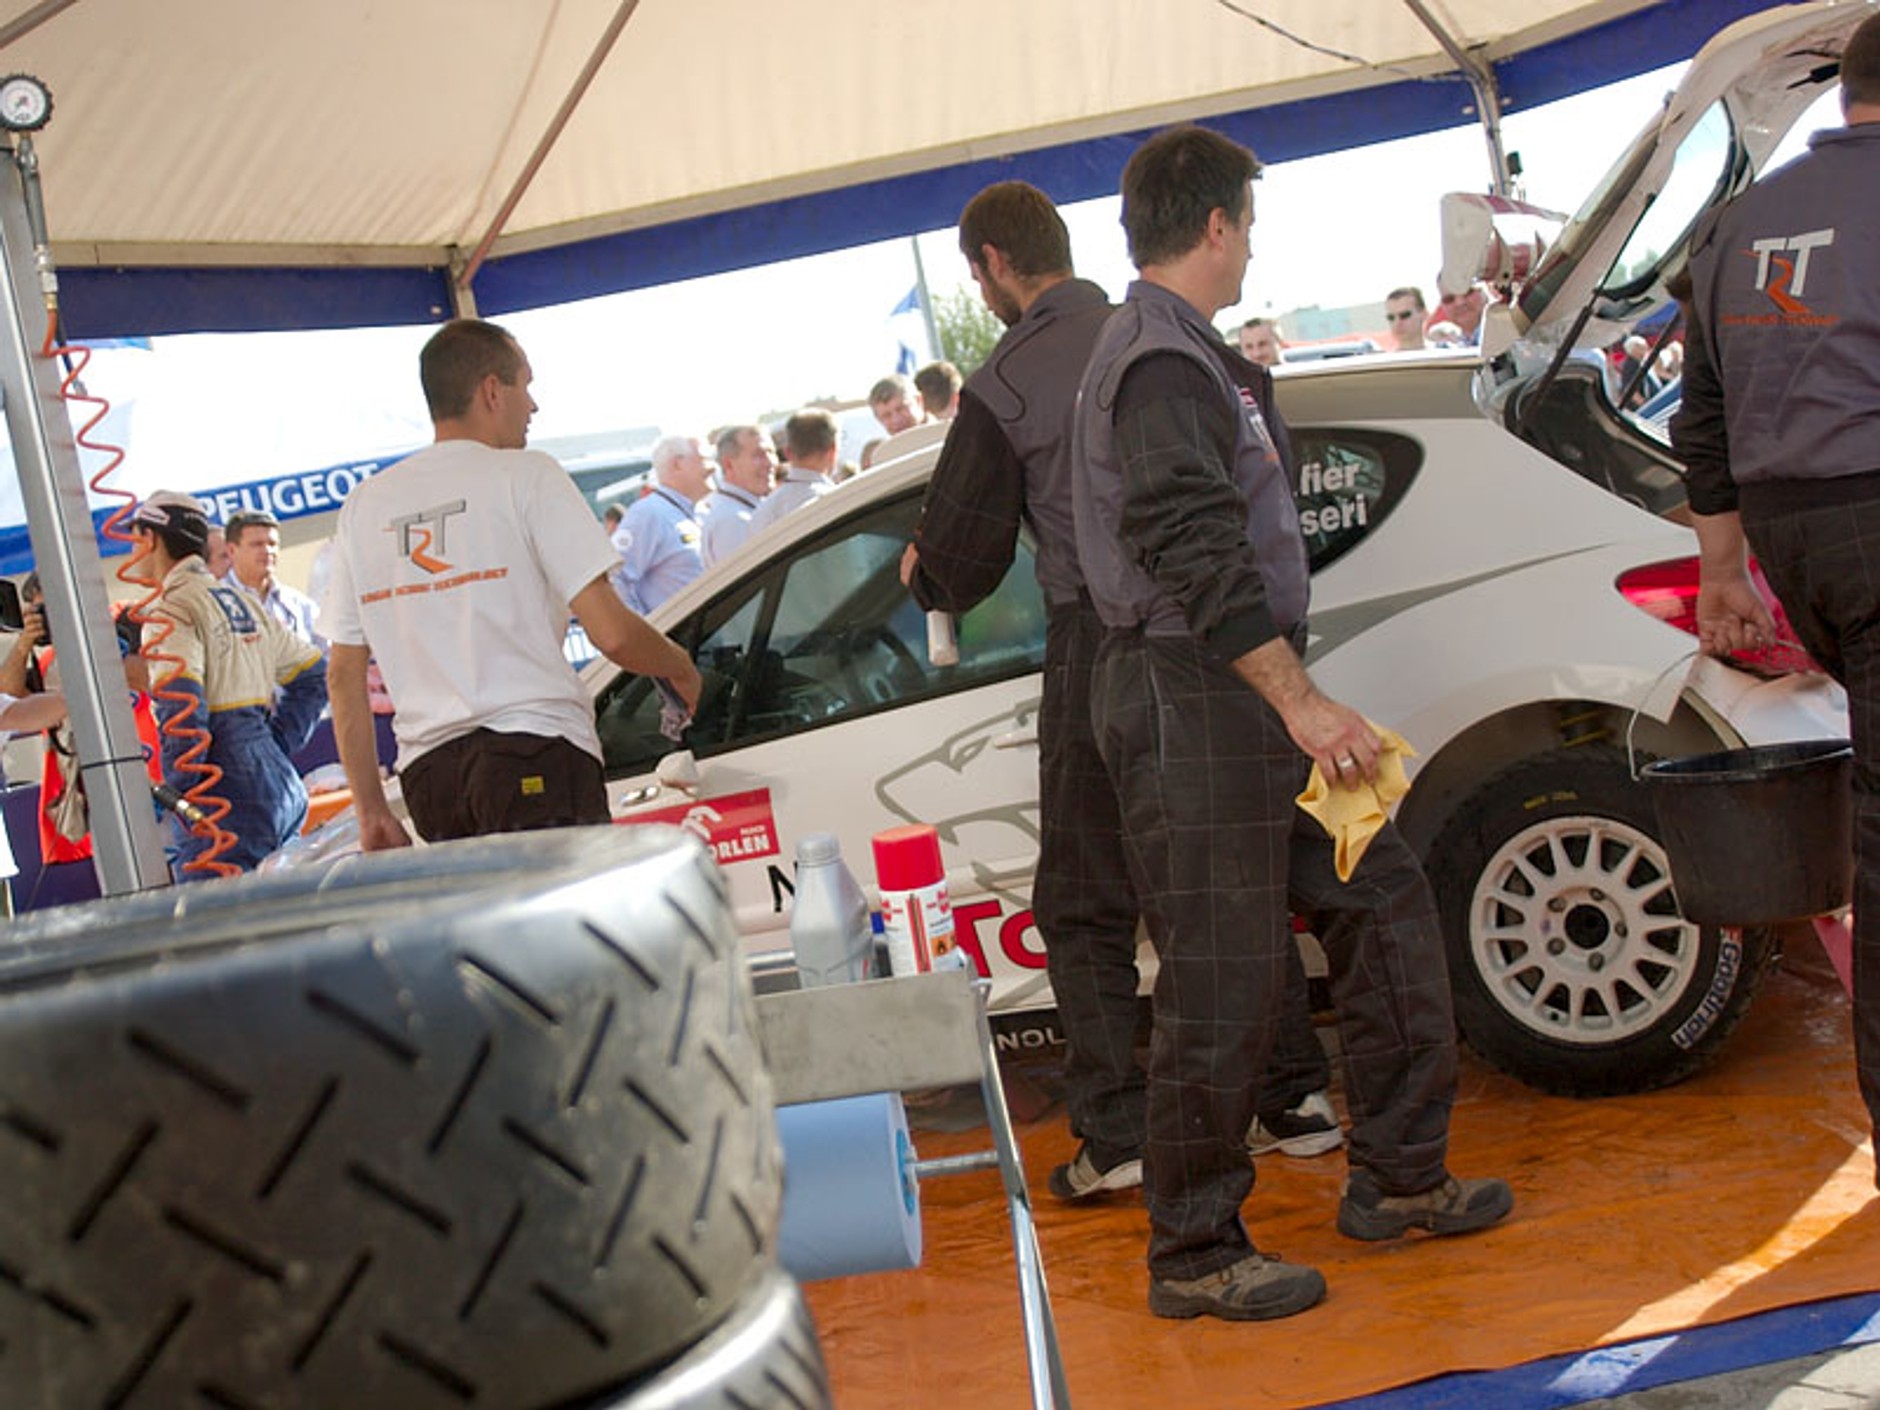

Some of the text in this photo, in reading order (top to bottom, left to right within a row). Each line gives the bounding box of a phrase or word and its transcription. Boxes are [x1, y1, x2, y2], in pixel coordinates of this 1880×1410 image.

[198, 463, 378, 527] PEUGEOT
[1294, 462, 1360, 497] fier
[1300, 493, 1367, 536] seri
[996, 1027, 1068, 1050] NOL
